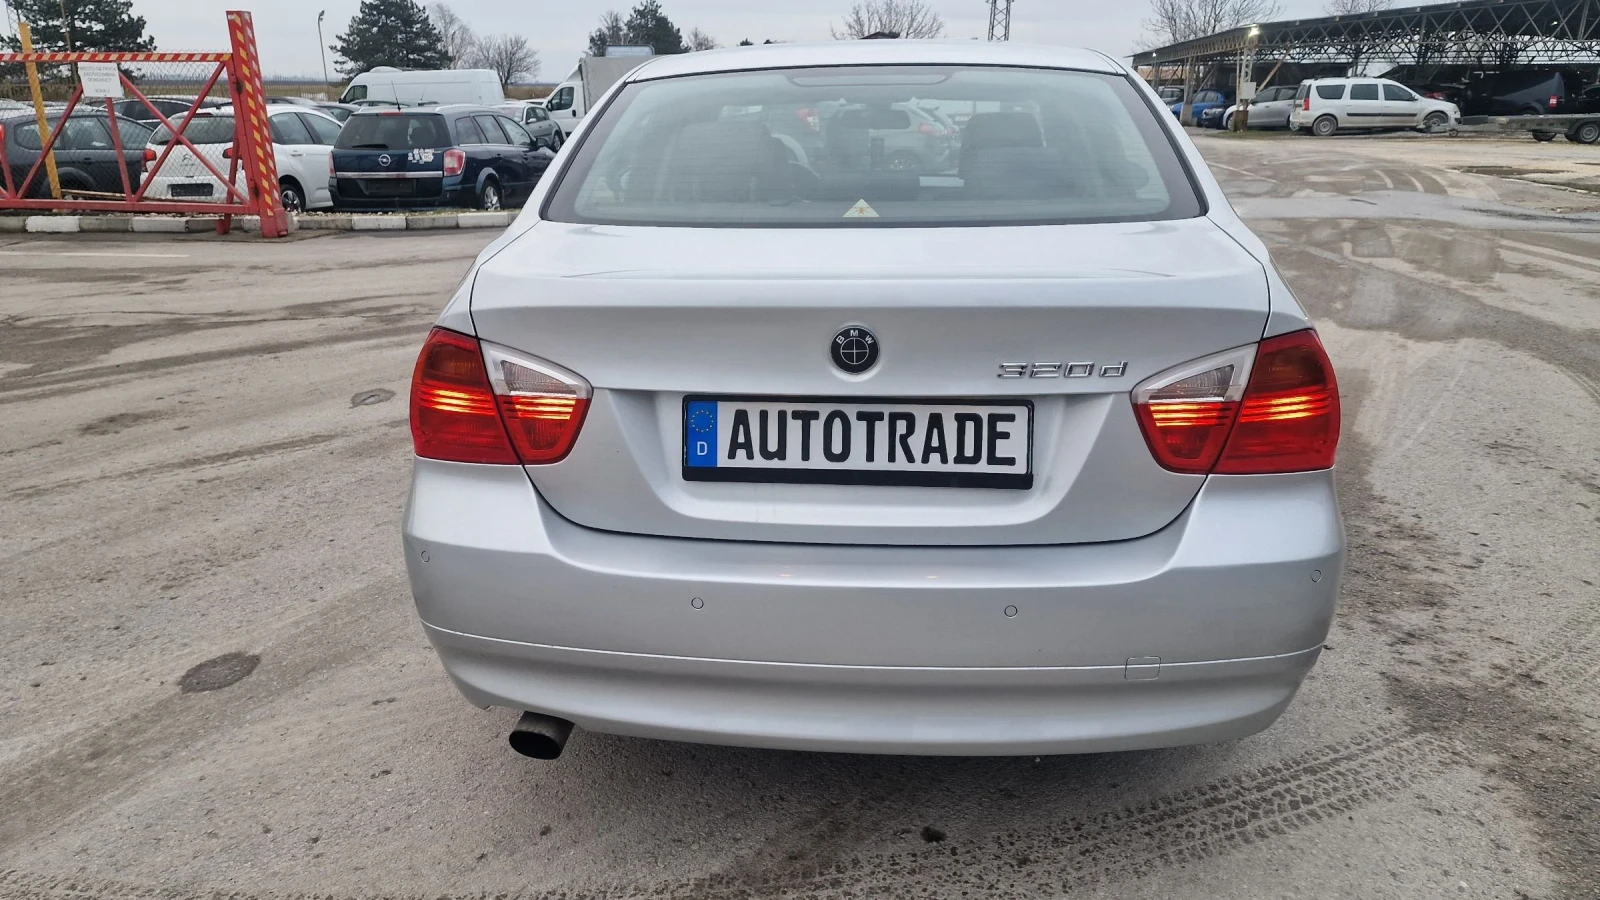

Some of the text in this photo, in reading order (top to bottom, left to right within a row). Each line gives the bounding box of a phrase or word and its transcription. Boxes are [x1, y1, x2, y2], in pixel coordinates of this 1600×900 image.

[835, 329, 875, 344] BMW
[996, 361, 1129, 379] 320d
[697, 409, 1017, 467] D AUTOTRADE
